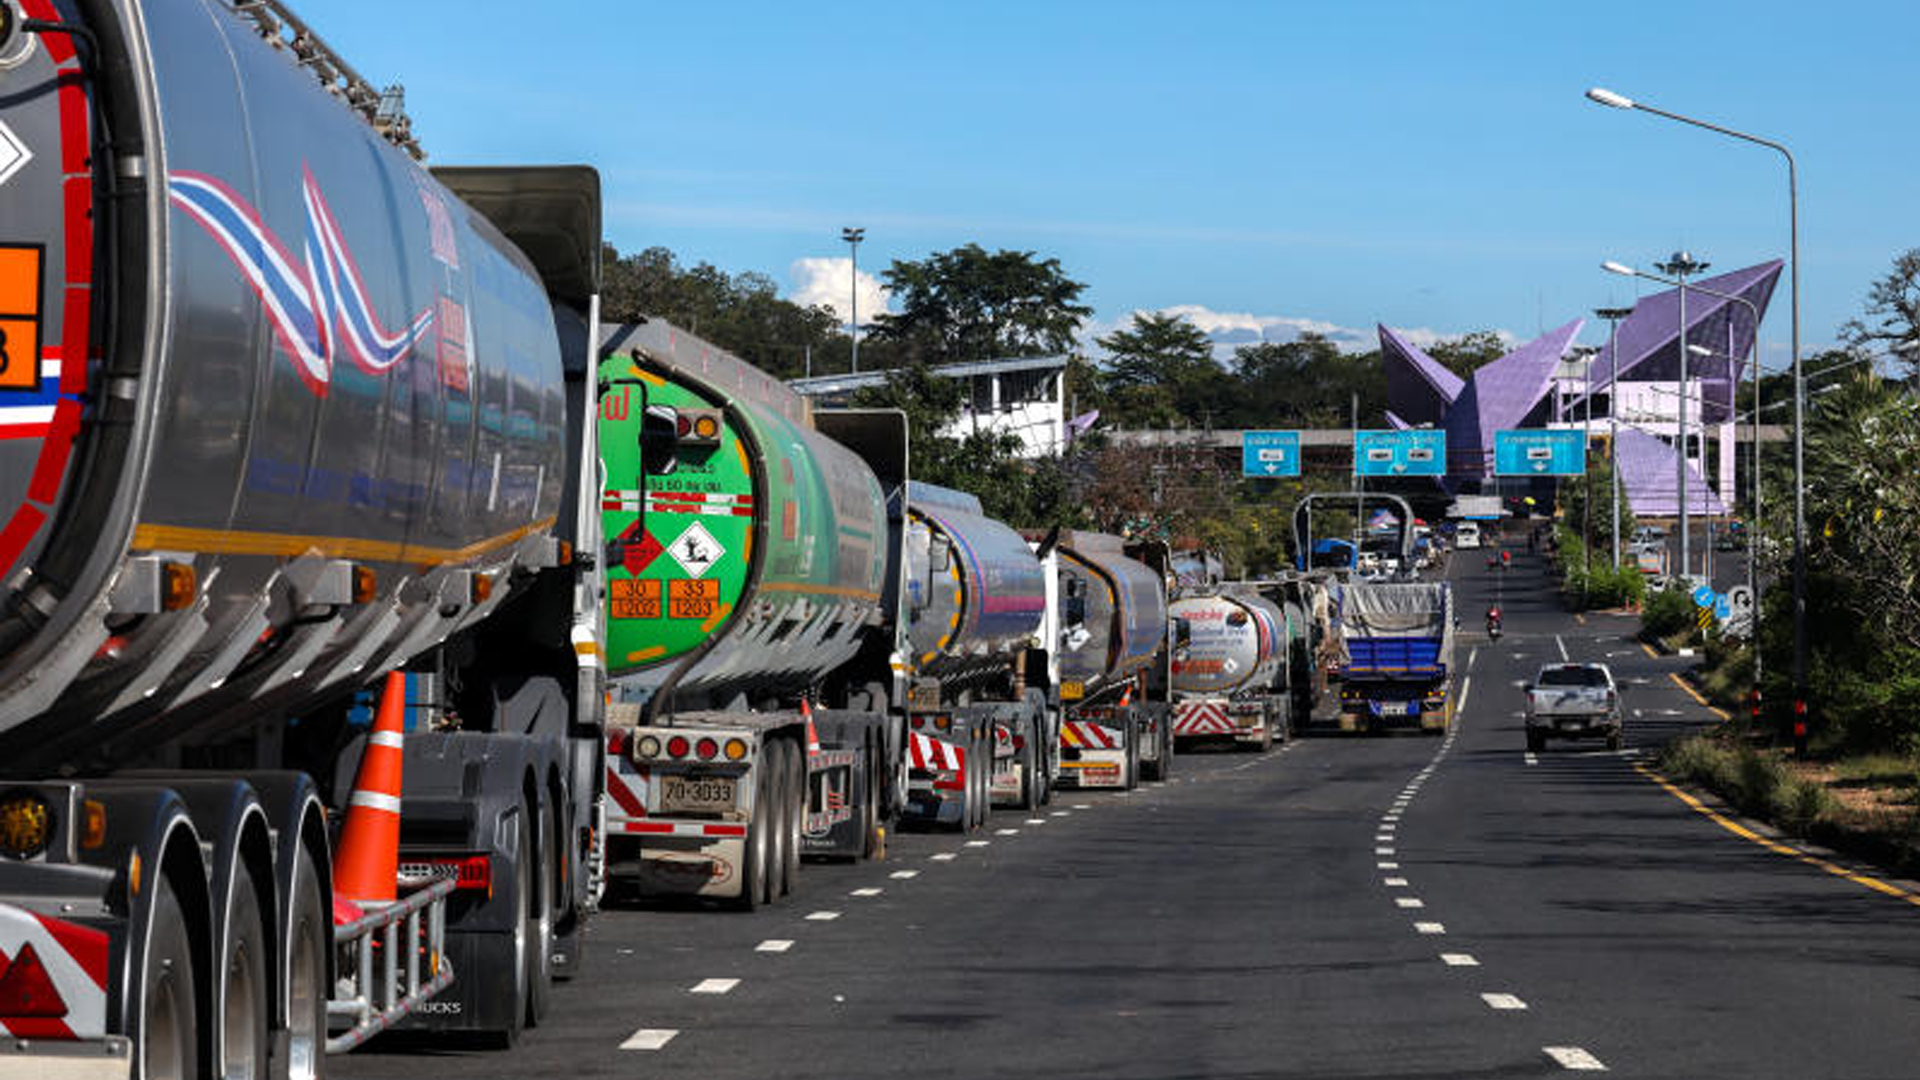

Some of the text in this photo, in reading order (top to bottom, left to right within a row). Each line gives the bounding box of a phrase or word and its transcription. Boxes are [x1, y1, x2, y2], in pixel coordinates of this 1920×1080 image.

[626, 581, 647, 597] 30
[684, 581, 705, 597] 33
[618, 599, 657, 616] 1202
[675, 599, 712, 616] 1203
[666, 783, 732, 802] 70-3033
[423, 1001, 462, 1014] UCKS
